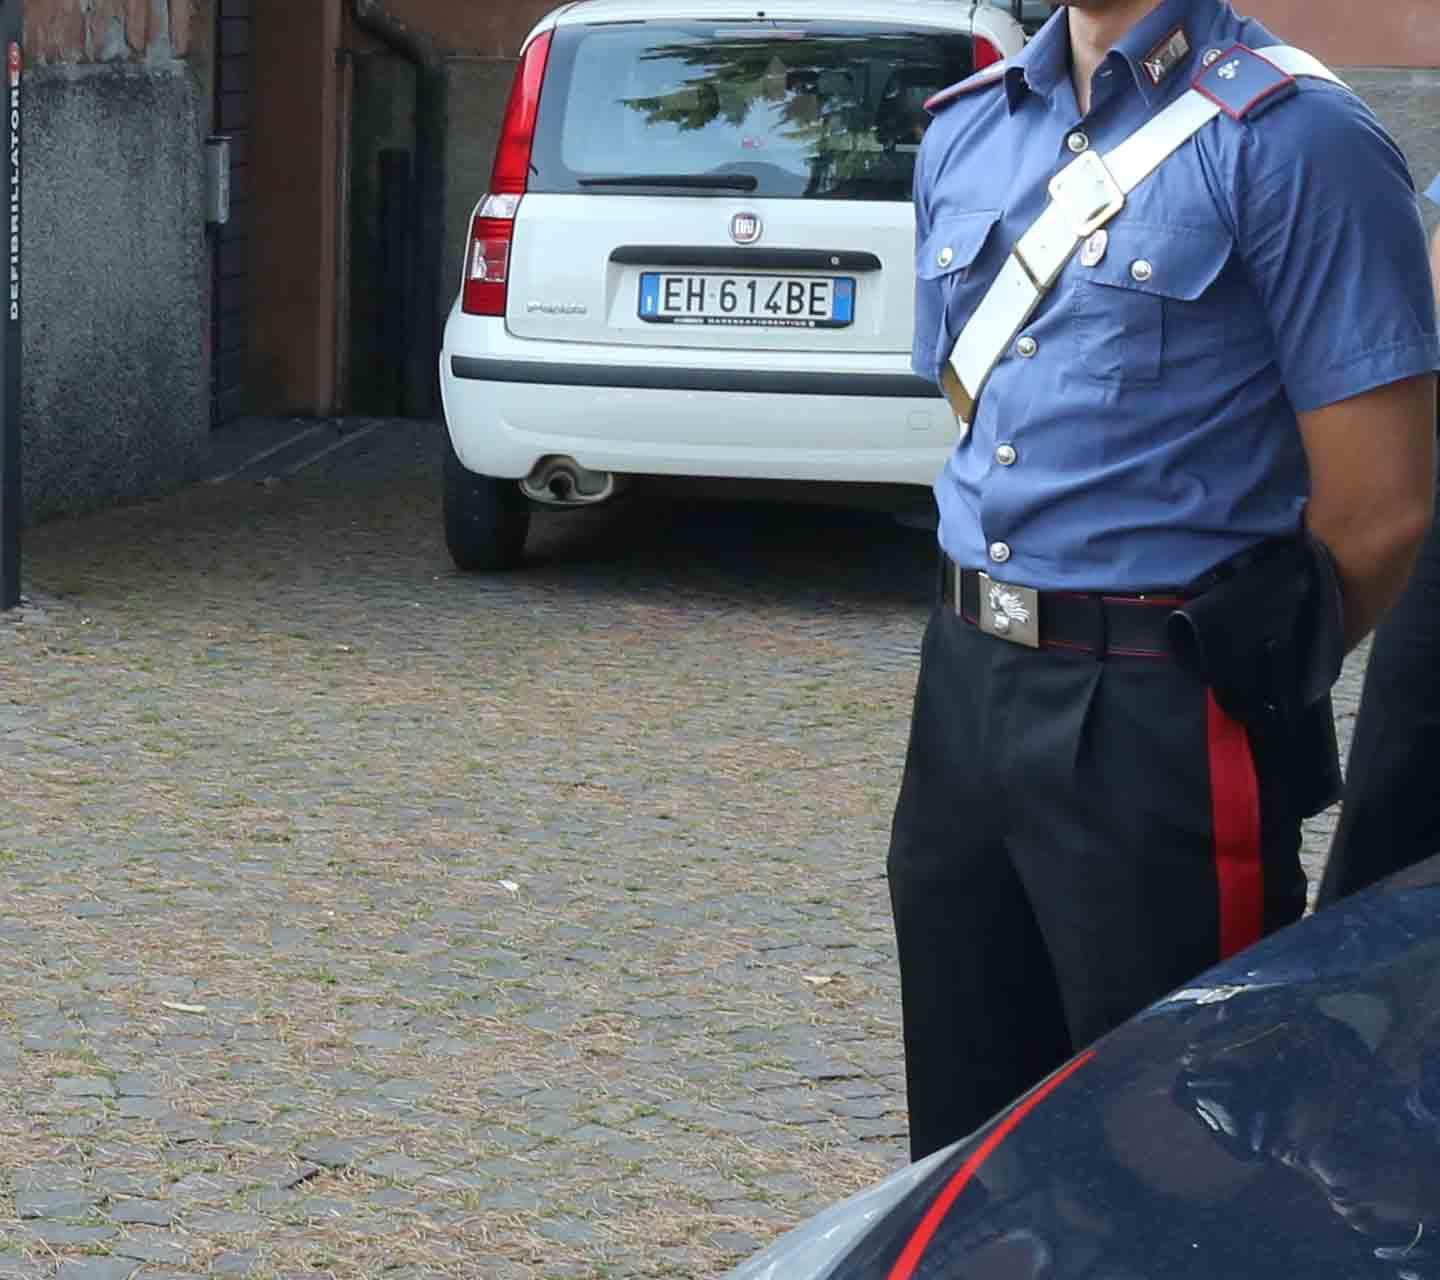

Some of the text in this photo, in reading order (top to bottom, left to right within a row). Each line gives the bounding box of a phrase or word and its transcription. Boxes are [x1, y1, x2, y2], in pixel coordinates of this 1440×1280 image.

[9, 71, 20, 320] DEFIBRILLATORE
[663, 277, 829, 316] EH 614BE
